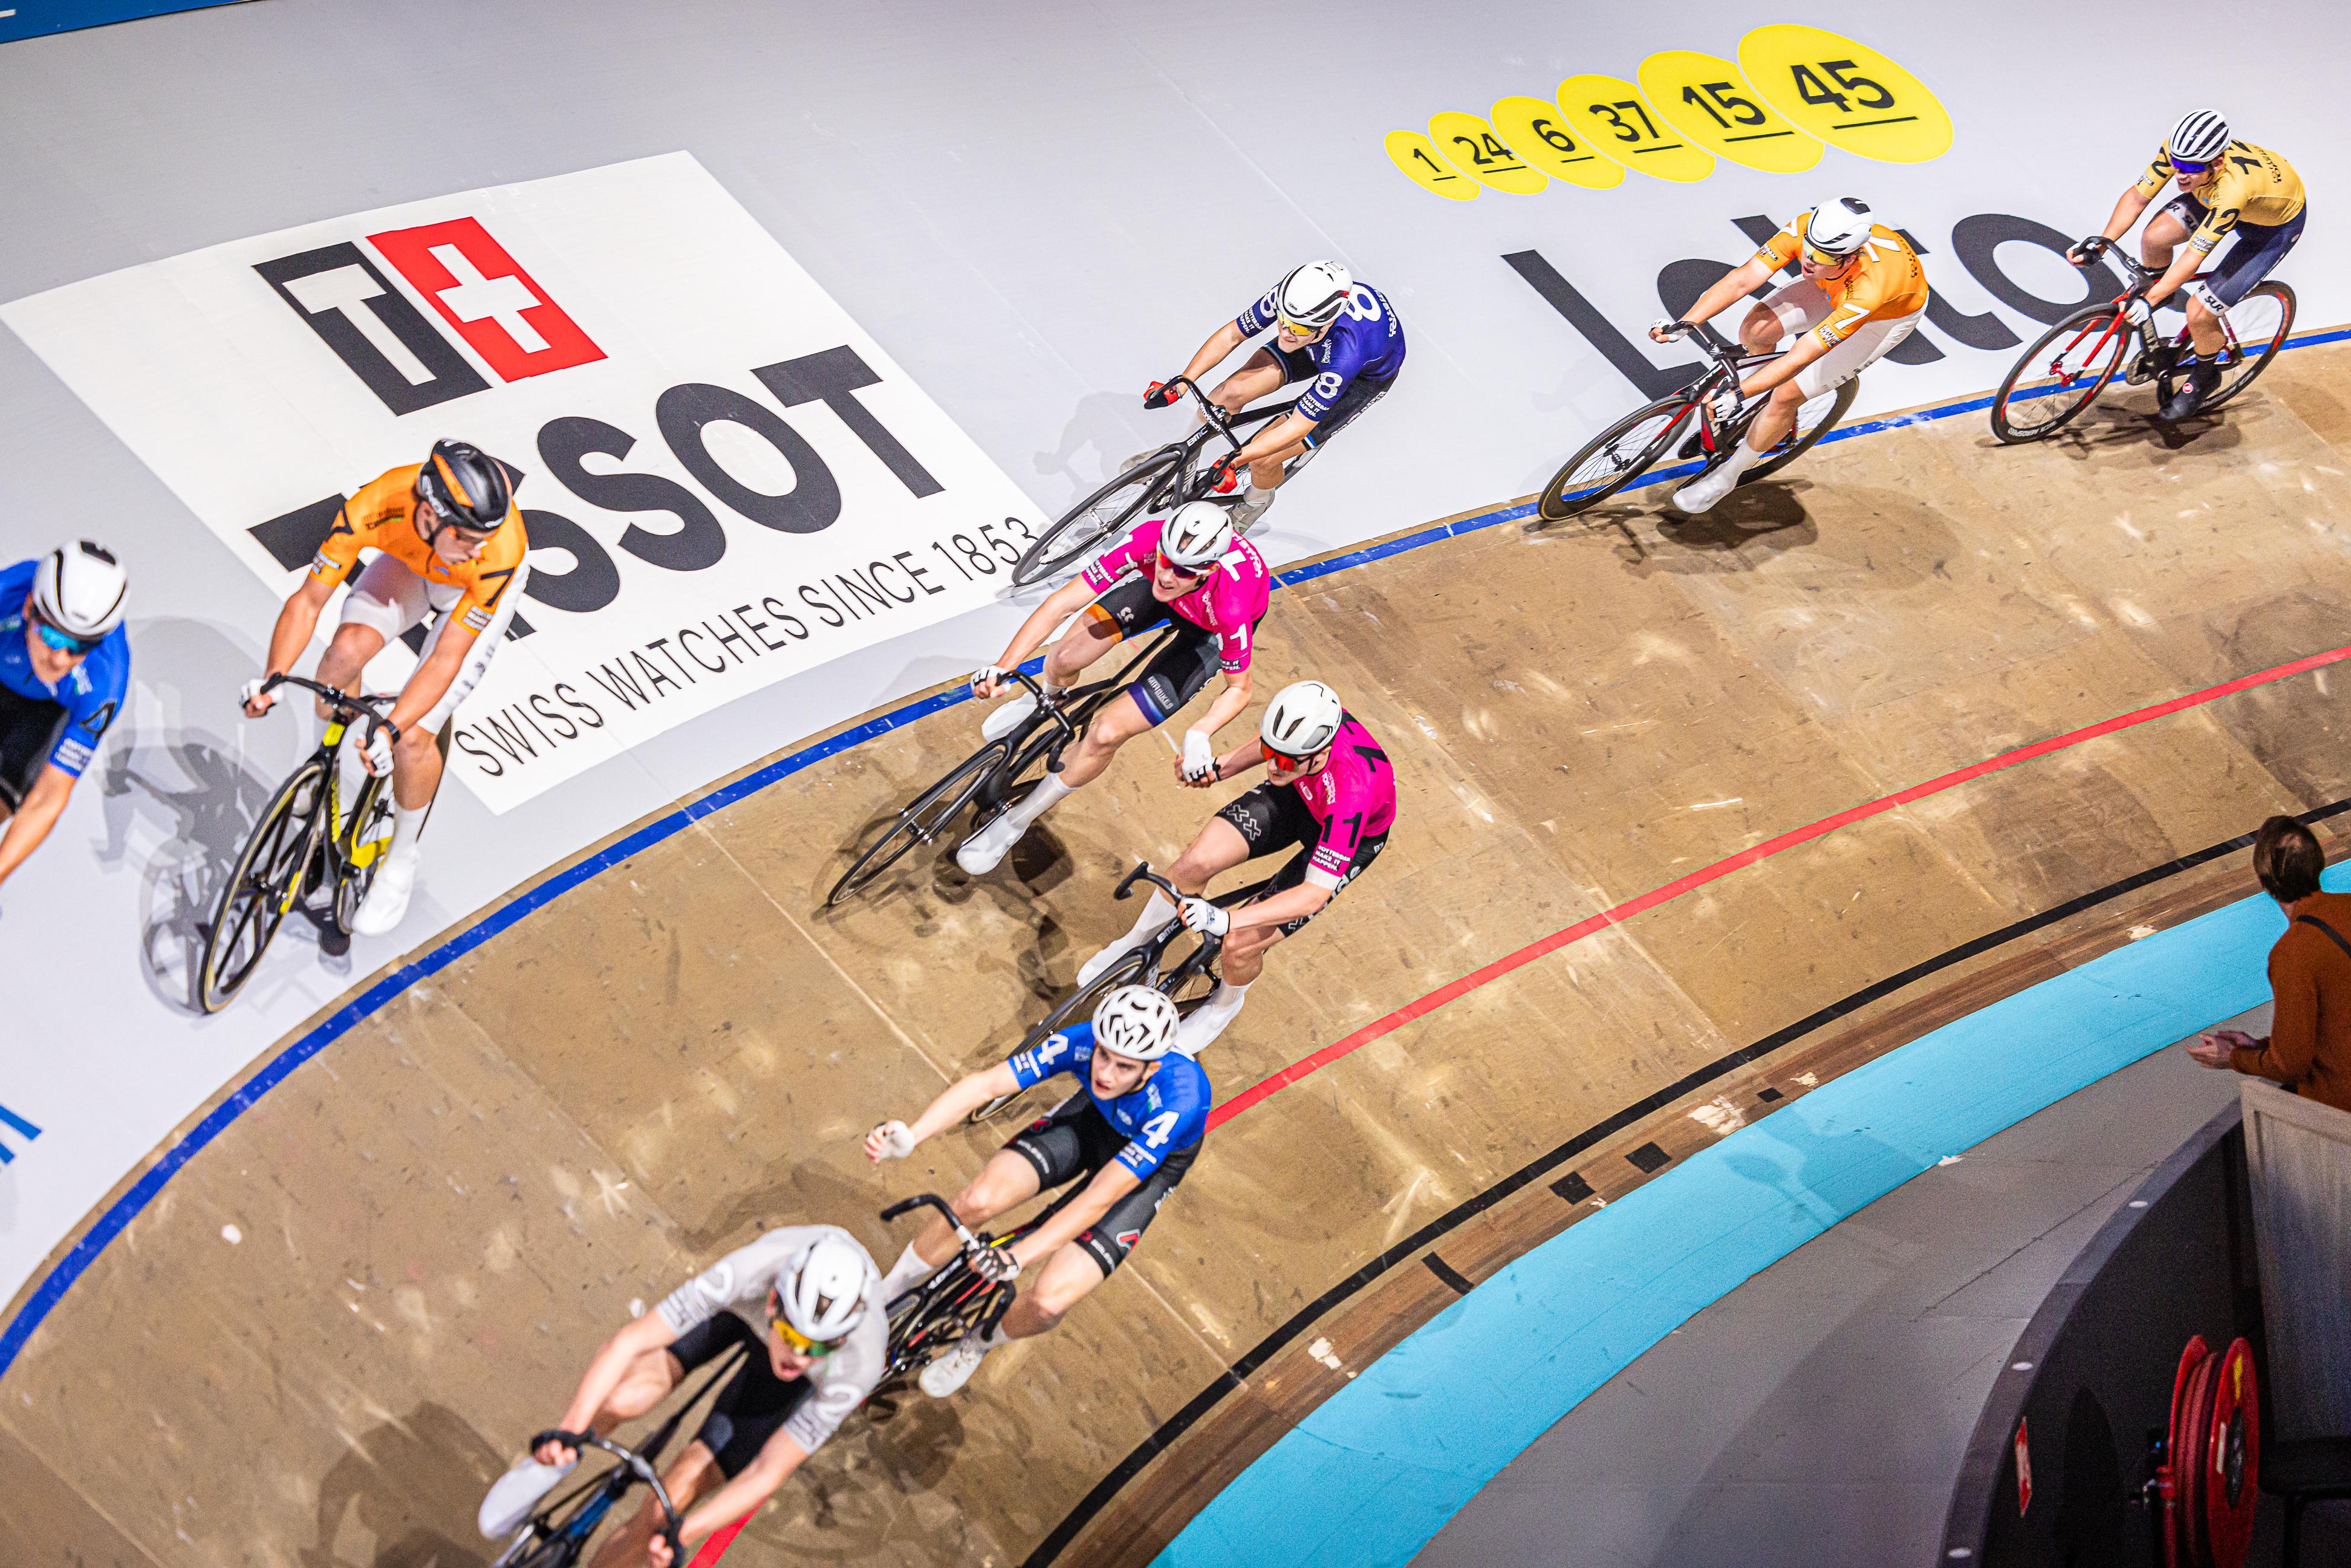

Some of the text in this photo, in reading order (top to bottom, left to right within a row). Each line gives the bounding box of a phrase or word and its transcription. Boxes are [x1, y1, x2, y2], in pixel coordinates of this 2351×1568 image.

[1414, 59, 1895, 173] 1 24 6 37 15 45
[2203, 207, 2240, 235] 12
[1260, 285, 1279, 318] 8
[2205, 295, 2225, 312] SLR
[1835, 303, 1871, 331] 7
[1315, 371, 1343, 399] 8
[1186, 426, 1208, 447] BMC
[480, 567, 516, 607] 7
[454, 683, 604, 777] SWISS
[585, 597, 809, 711] WATCHES
[798, 551, 947, 628] SINCE
[1312, 855, 1338, 872] HAPPEN.
[1315, 850, 1333, 862] MAKE
[1318, 845, 1351, 862] ROTTERDAM
[1037, 1033, 1069, 1066] 4
[1142, 1111, 1180, 1150] 4
